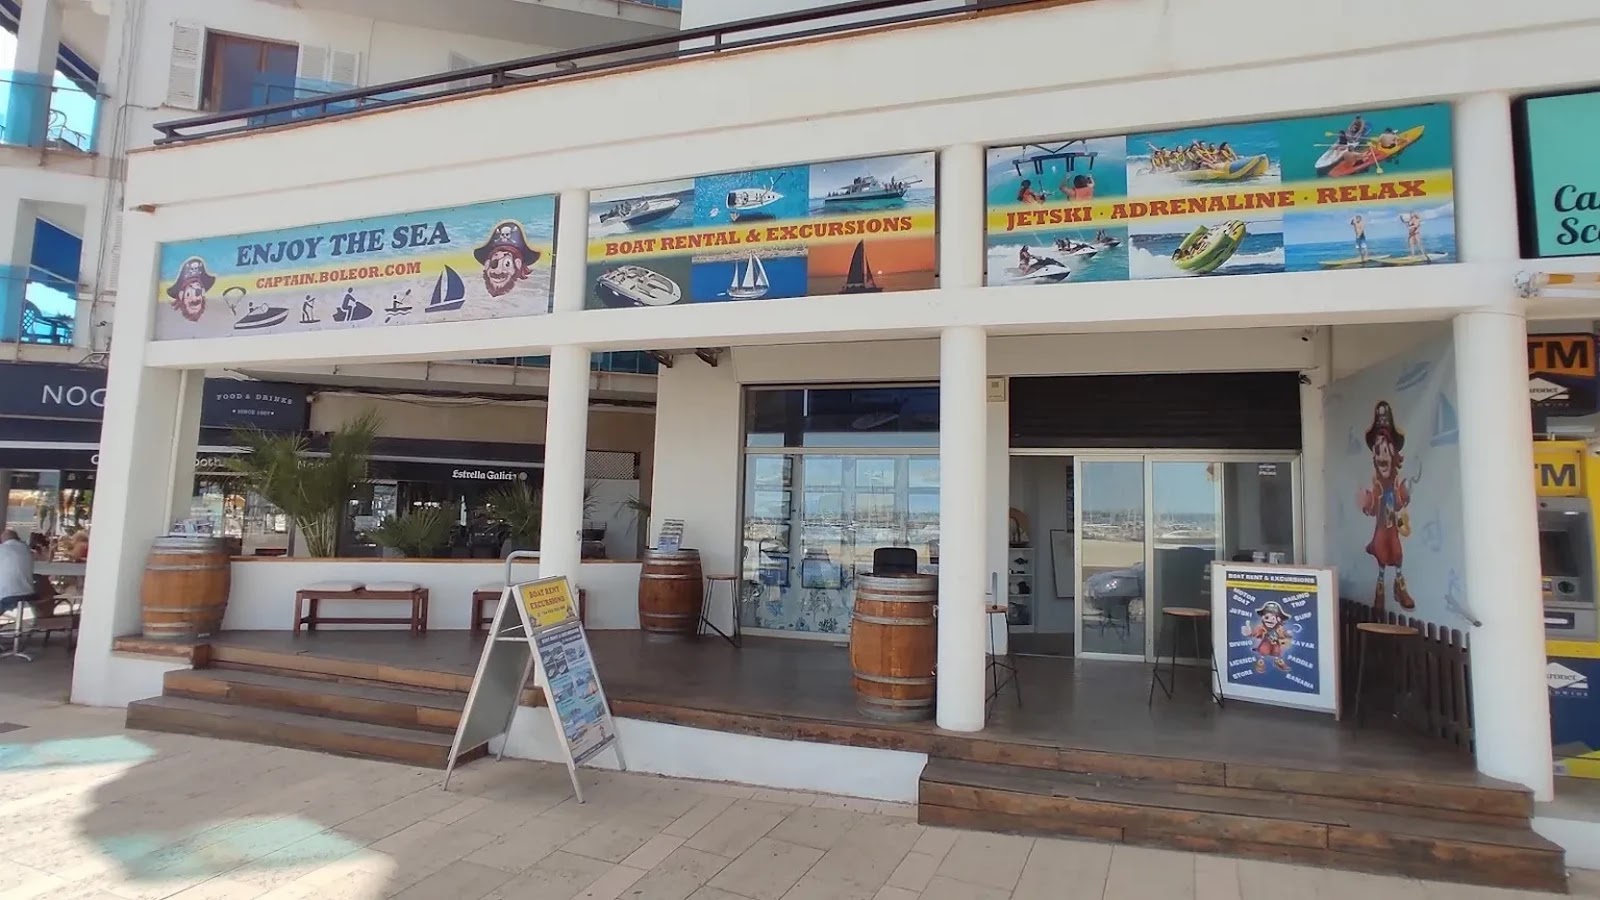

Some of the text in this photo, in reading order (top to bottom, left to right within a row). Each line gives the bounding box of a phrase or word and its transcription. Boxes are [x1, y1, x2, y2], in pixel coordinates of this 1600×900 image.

[1554, 184, 1600, 212] Ca
[1006, 179, 1427, 231] JETSKI ADRENALINE RELAX
[605, 216, 913, 256] BOAT RENTAL & EXCURSIONS
[236, 221, 450, 266] ENJOY THE SEA
[255, 261, 421, 289] CAPTAIN.BOLEOR.COM
[1527, 340, 1589, 369] TM
[216, 393, 242, 401] FOOD
[255, 394, 293, 405] DRINKS
[451, 469, 486, 480] Estrella
[1270, 575, 1315, 583] EXCURSIONS
[1232, 594, 1251, 606] BOAT
[1233, 587, 1256, 602] MOTOR
[1282, 592, 1310, 604] SAILING
[1291, 600, 1306, 609] TRIP
[1229, 608, 1252, 617] JETSKI
[1293, 612, 1312, 621] SURF
[1228, 640, 1253, 648] DIVING
[1291, 640, 1316, 649] KAYAK
[1287, 654, 1314, 669] PADDLE
[1232, 669, 1253, 680] STORE
[1285, 673, 1314, 690] BANANA
